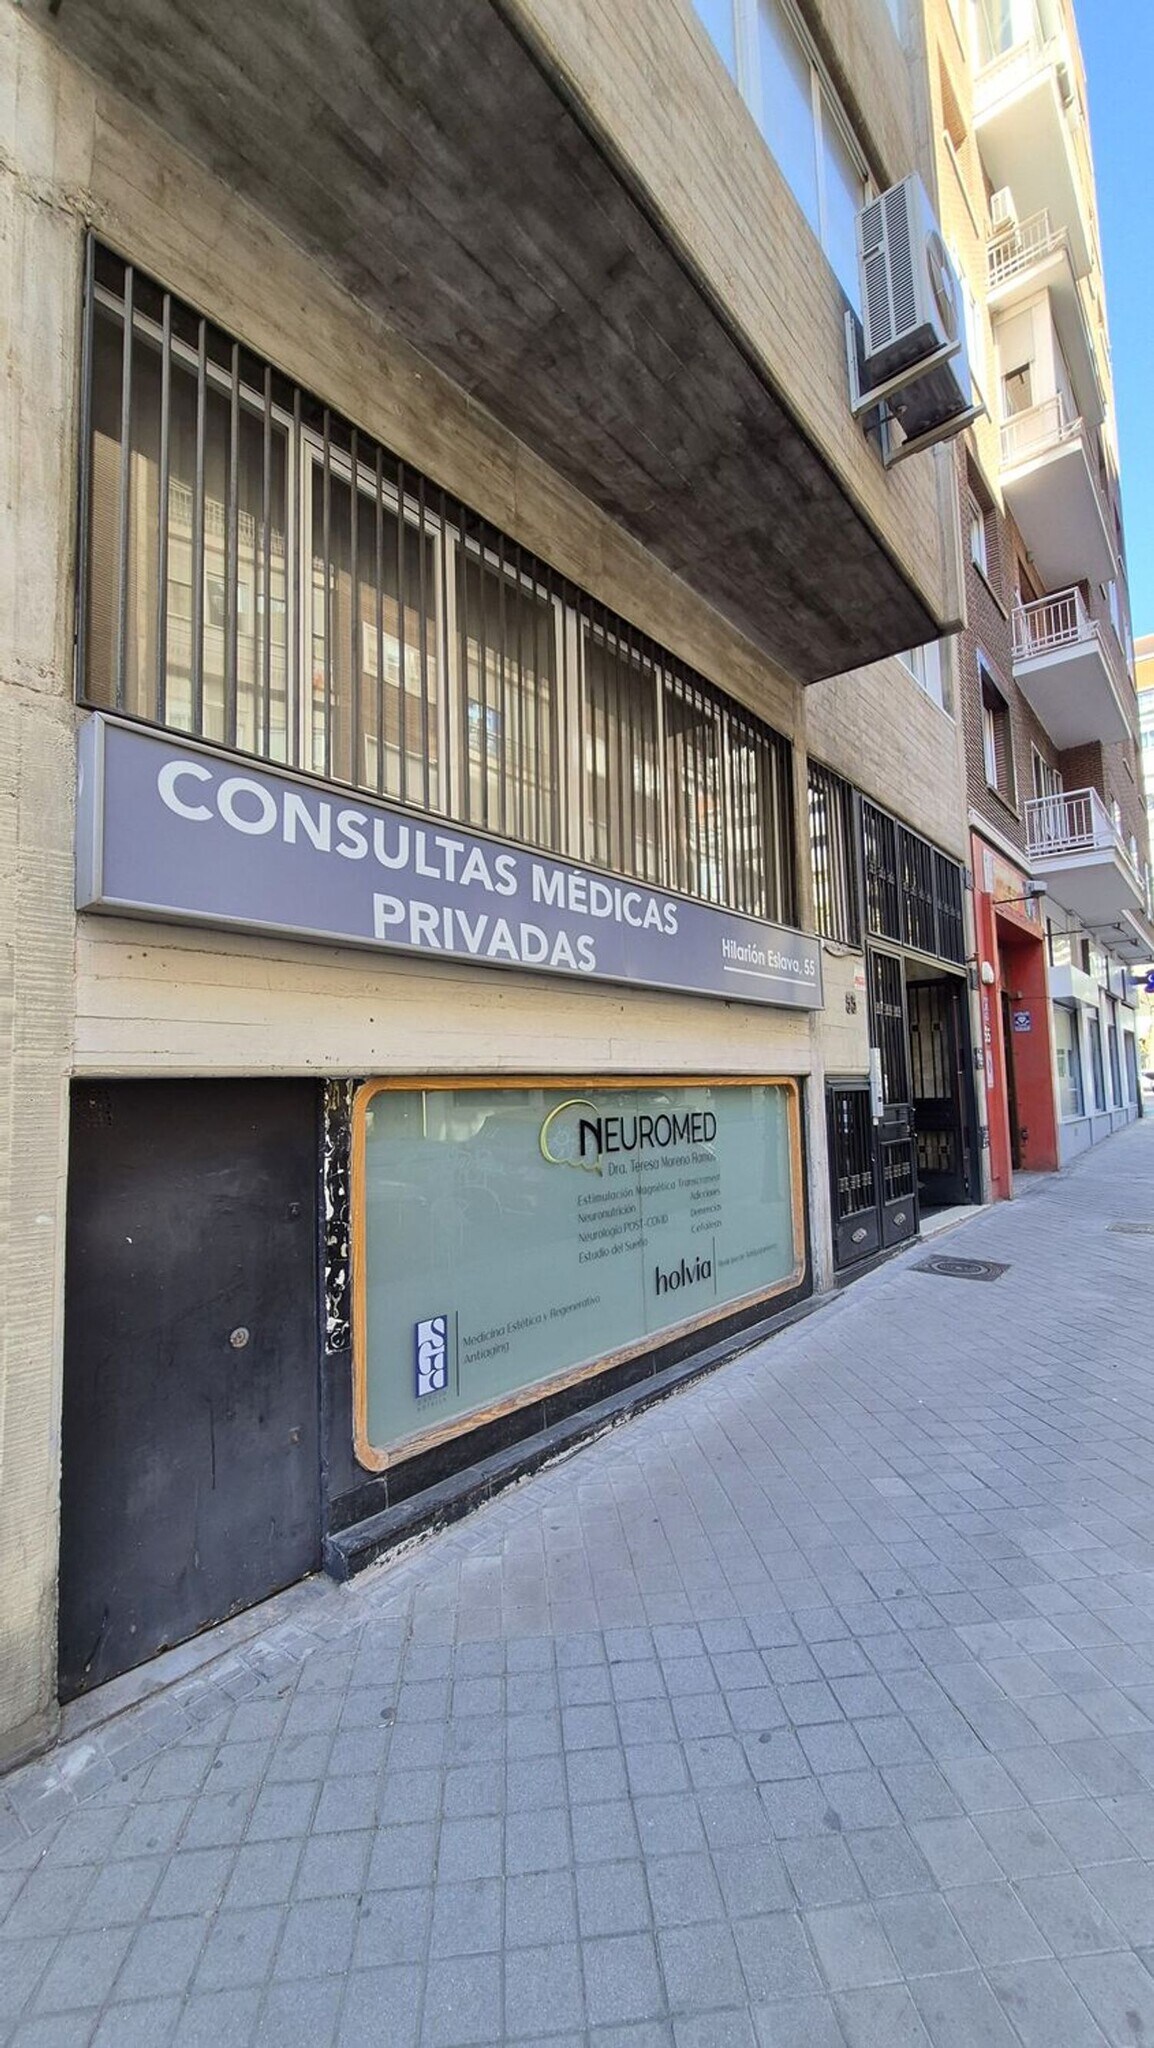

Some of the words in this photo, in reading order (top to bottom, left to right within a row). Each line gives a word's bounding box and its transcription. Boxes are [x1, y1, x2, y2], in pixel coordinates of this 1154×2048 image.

[157, 760, 519, 896] CONSULTAS
[533, 863, 679, 935] MÉDICAS
[373, 893, 597, 973] PRIVADAS
[722, 938, 765, 966] Hilarión
[804, 959, 815, 976] 55
[579, 1112, 717, 1156] NEUROMED
[608, 1162, 628, 1176] Dra.
[631, 1159, 660, 1173] Teresa
[577, 1187, 634, 1206] Estimulación
[579, 1247, 610, 1264] Estudio
[655, 1256, 712, 1295] holvia
[463, 1326, 506, 1347] Medicina
[507, 1314, 542, 1334] Estética
